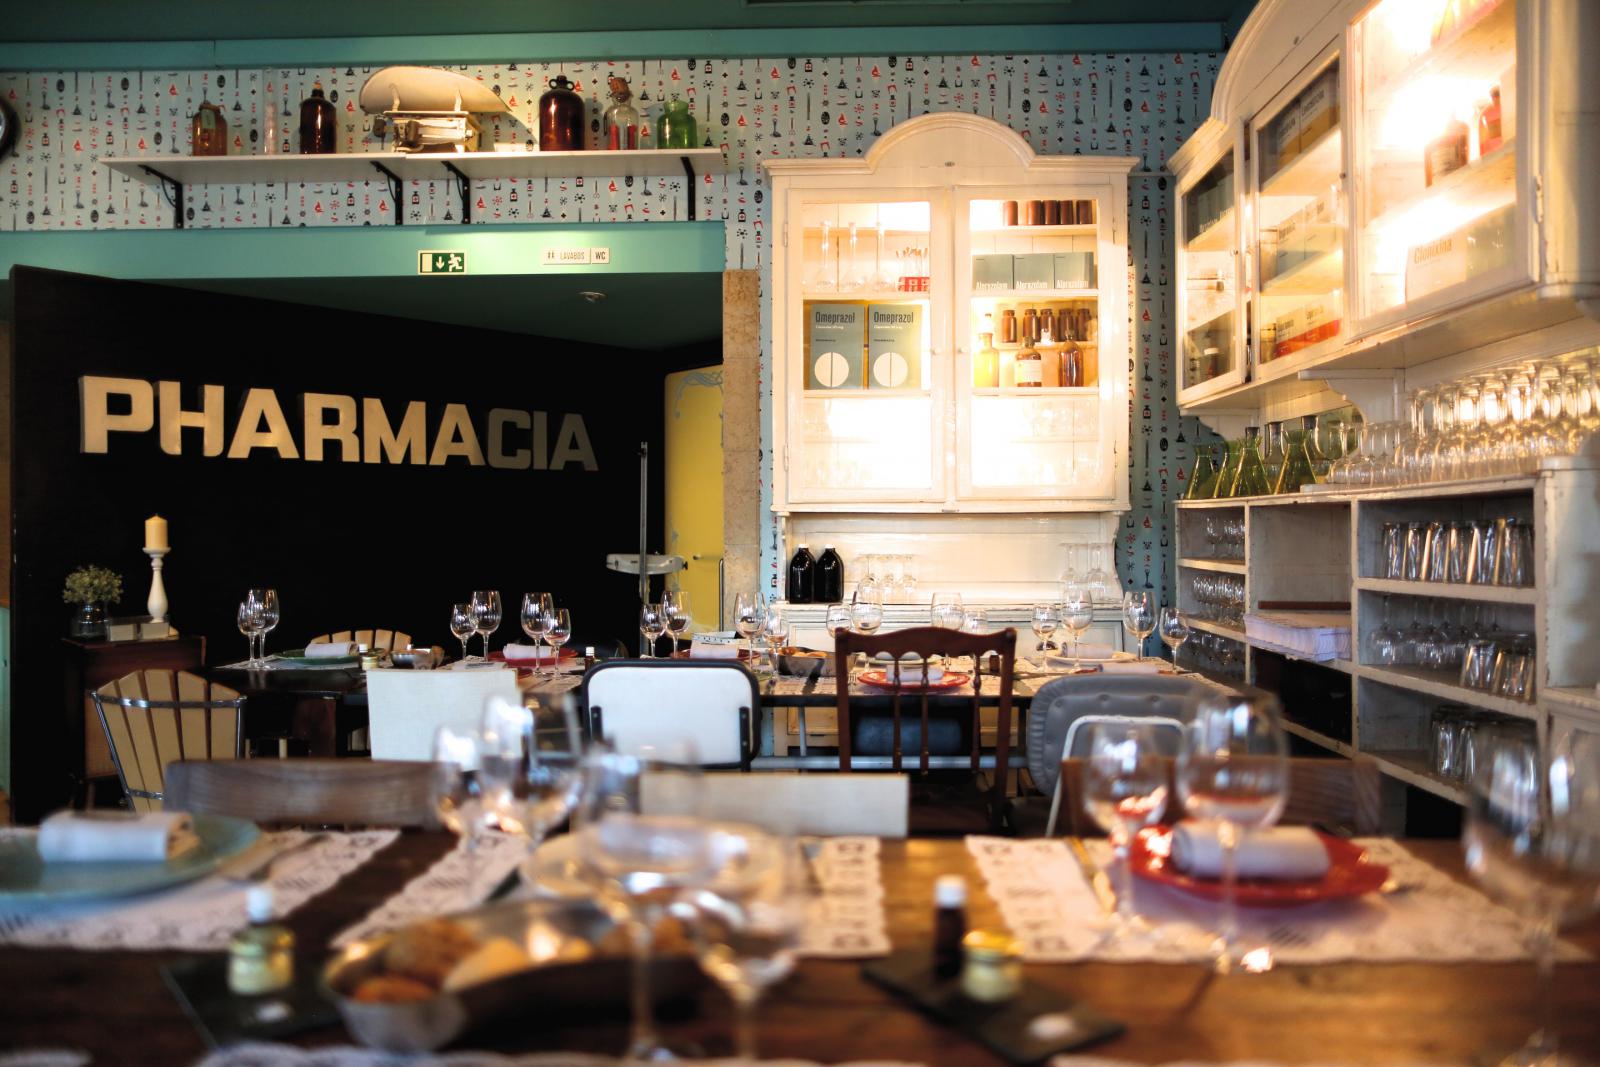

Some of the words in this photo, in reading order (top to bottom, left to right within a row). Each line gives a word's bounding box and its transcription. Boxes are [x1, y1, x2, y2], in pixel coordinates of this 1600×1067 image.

[595, 251, 606, 260] WC
[815, 311, 855, 324] Omeprazol
[873, 311, 914, 324] Omeprazol
[78, 375, 599, 471] PHARMACIA
